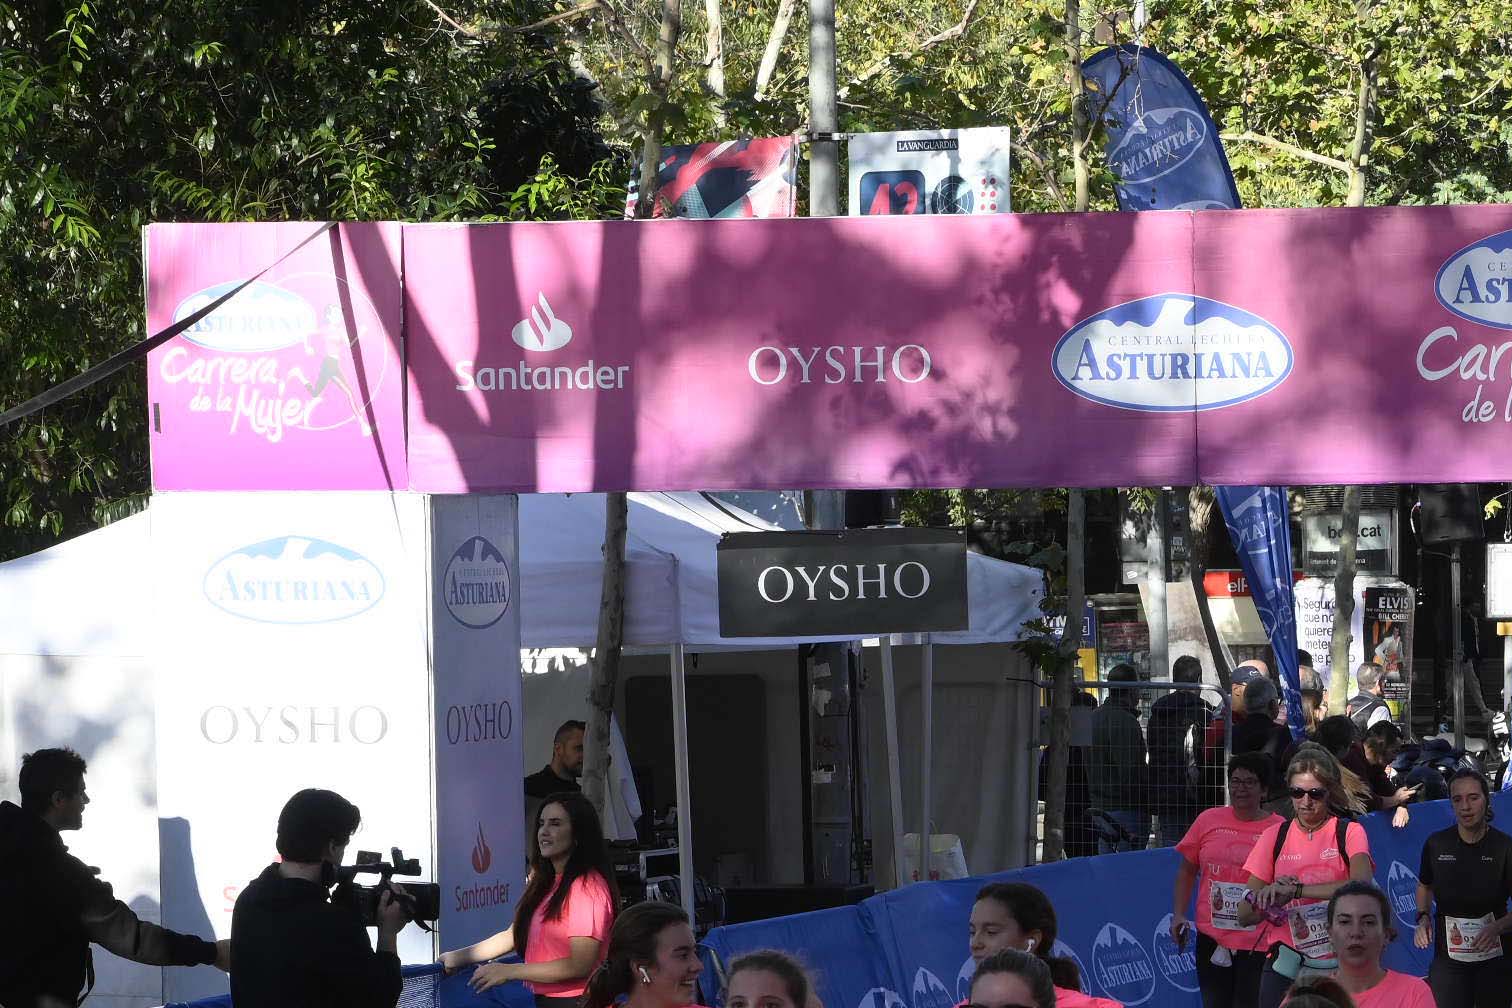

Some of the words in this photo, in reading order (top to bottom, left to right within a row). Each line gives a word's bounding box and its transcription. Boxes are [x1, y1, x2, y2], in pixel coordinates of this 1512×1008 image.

[1108, 335, 1183, 346] CENTRAL
[160, 347, 278, 384] Carrera
[456, 360, 629, 392] Santander
[748, 344, 931, 385] OYSHO
[1070, 338, 1274, 382] ASTURIANA
[230, 377, 323, 443] Mujer
[1462, 385, 1496, 422] de
[219, 568, 372, 601] ASTURIANA
[449, 572, 506, 606] ASTURIANA
[758, 560, 931, 604] OYSHO
[1379, 596, 1409, 609] ELVIS
[200, 705, 388, 744] OYSHO
[446, 700, 512, 745] OYSHO
[455, 882, 511, 913] Santander
[1101, 959, 1150, 986] ASTURIANA
